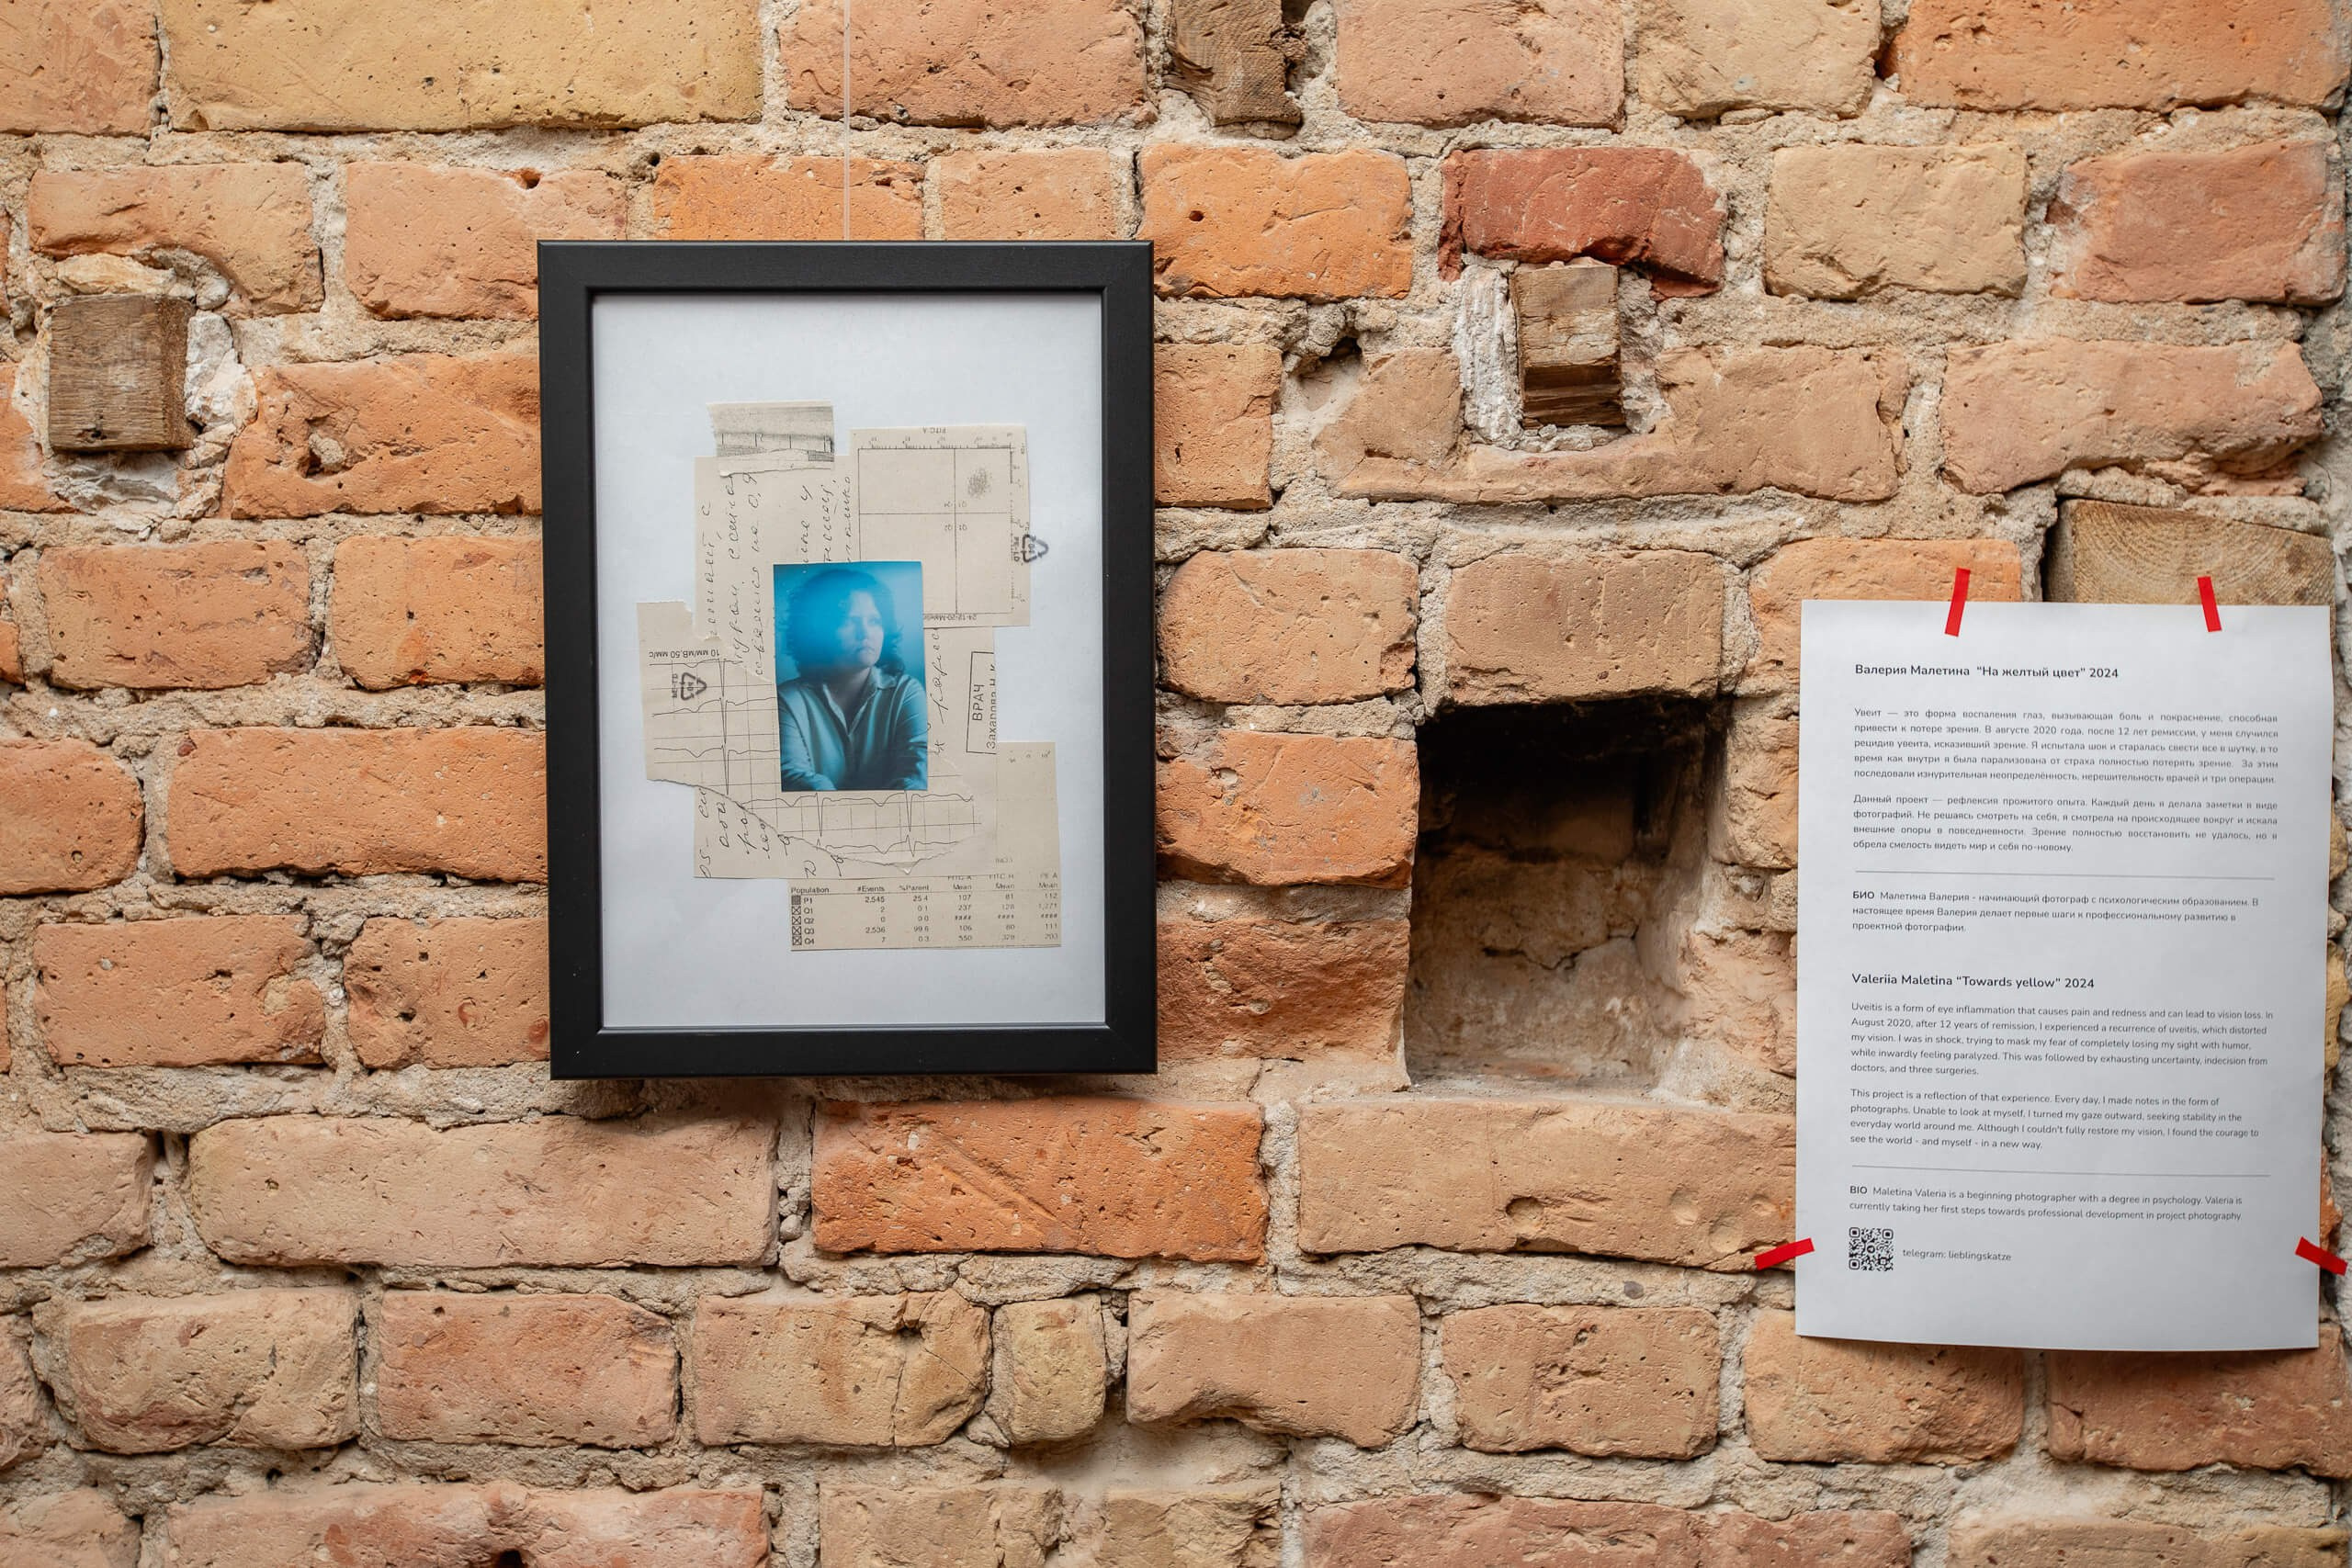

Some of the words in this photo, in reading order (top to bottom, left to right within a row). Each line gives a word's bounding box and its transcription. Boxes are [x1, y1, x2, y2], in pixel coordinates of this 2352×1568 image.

[1855, 664, 1907, 676] Валерия
[1910, 664, 1970, 675] Малетина
[2002, 666, 2049, 677] желтый
[2089, 667, 2118, 678] 2024
[972, 684, 985, 721] ВРАЧ
[1854, 725, 1897, 733] привести
[1910, 725, 1942, 734] потере
[1984, 724, 1992, 733] В
[1995, 727, 2029, 735] августе
[2033, 725, 2057, 735] 2020
[2118, 727, 2129, 735] 12
[2235, 730, 2278, 739] случился
[791, 887, 829, 895] Population
[1852, 907, 1903, 916] настоящее
[1905, 908, 1934, 917] время
[1936, 907, 1977, 918] Валерия
[1979, 910, 2012, 918] делает
[2014, 910, 2049, 919] первые
[2085, 910, 2182, 922] профессиональному
[2184, 914, 2228, 922] развитию
[1852, 921, 1902, 932] проектной
[1851, 973, 1897, 984] Valeriia
[1901, 974, 1952, 985] Maletina
[2064, 977, 2094, 988] 2024
[1850, 1017, 1884, 1028] August
[1915, 1019, 1937, 1028] after
[1940, 1019, 1951, 1028] 12
[1953, 1022, 1978, 1030] years
[1980, 1021, 1989, 1029] of
[2039, 1021, 2042, 1030] I
[2044, 1022, 2099, 1033] experienced
[2157, 1024, 2167, 1033] of
[2201, 1025, 2227, 1034] which
[2229, 1026, 2267, 1034] distorted
[1850, 1034, 1865, 1042] my
[1898, 1033, 1901, 1042] I
[1924, 1034, 1933, 1043] in
[1966, 1035, 1992, 1046] trying
[1994, 1037, 2004, 1045] to
[2006, 1036, 2030, 1045] mask
[2032, 1039, 2047, 1047] my
[2048, 1037, 2066, 1046] fear
[2068, 1038, 2078, 1047] of
[2080, 1038, 2130, 1049] completely
[2131, 1040, 2159, 1050] losing
[2161, 1041, 2174, 1050] my
[2176, 1040, 2198, 1050] sight
[2200, 1040, 2220, 1049] with
[1850, 1047, 1876, 1057] while
[1878, 1049, 1918, 1059] inwardly
[1920, 1050, 1951, 1060] feeling
[2002, 1051, 2021, 1061] This
[2044, 1053, 2084, 1062] followed
[2086, 1054, 2098, 1064] by
[2100, 1054, 2149, 1065] exhausting
[2204, 1057, 2246, 1065] indecision
[2248, 1057, 2268, 1065] from
[1889, 1064, 1906, 1073] and
[1908, 1065, 1932, 1073] three
[1912, 1105, 1946, 1115] Unable
[1960, 1107, 1979, 1116] look
[2032, 1109, 2063, 1118] turned
[2065, 1112, 2079, 1120] my
[2081, 1112, 2102, 1121] gaze
[2146, 1111, 2180, 1122] seeking
[2182, 1112, 2216, 1122] stability
[2228, 1113, 2242, 1121] the
[1849, 1201, 1890, 1212] currently
[1892, 1202, 1921, 1214] taking
[1923, 1204, 1938, 1213] her
[1940, 1204, 1959, 1213] first
[1960, 1206, 1986, 1216] steps
[1987, 1207, 2025, 1216] towards
[2027, 1207, 2083, 1219] professional
[2085, 1209, 2144, 1220] development
[2156, 1212, 2185, 1221] project
[1902, 1248, 1946, 1260] telegram:
[1948, 1250, 2012, 1262] lieblingskatze
